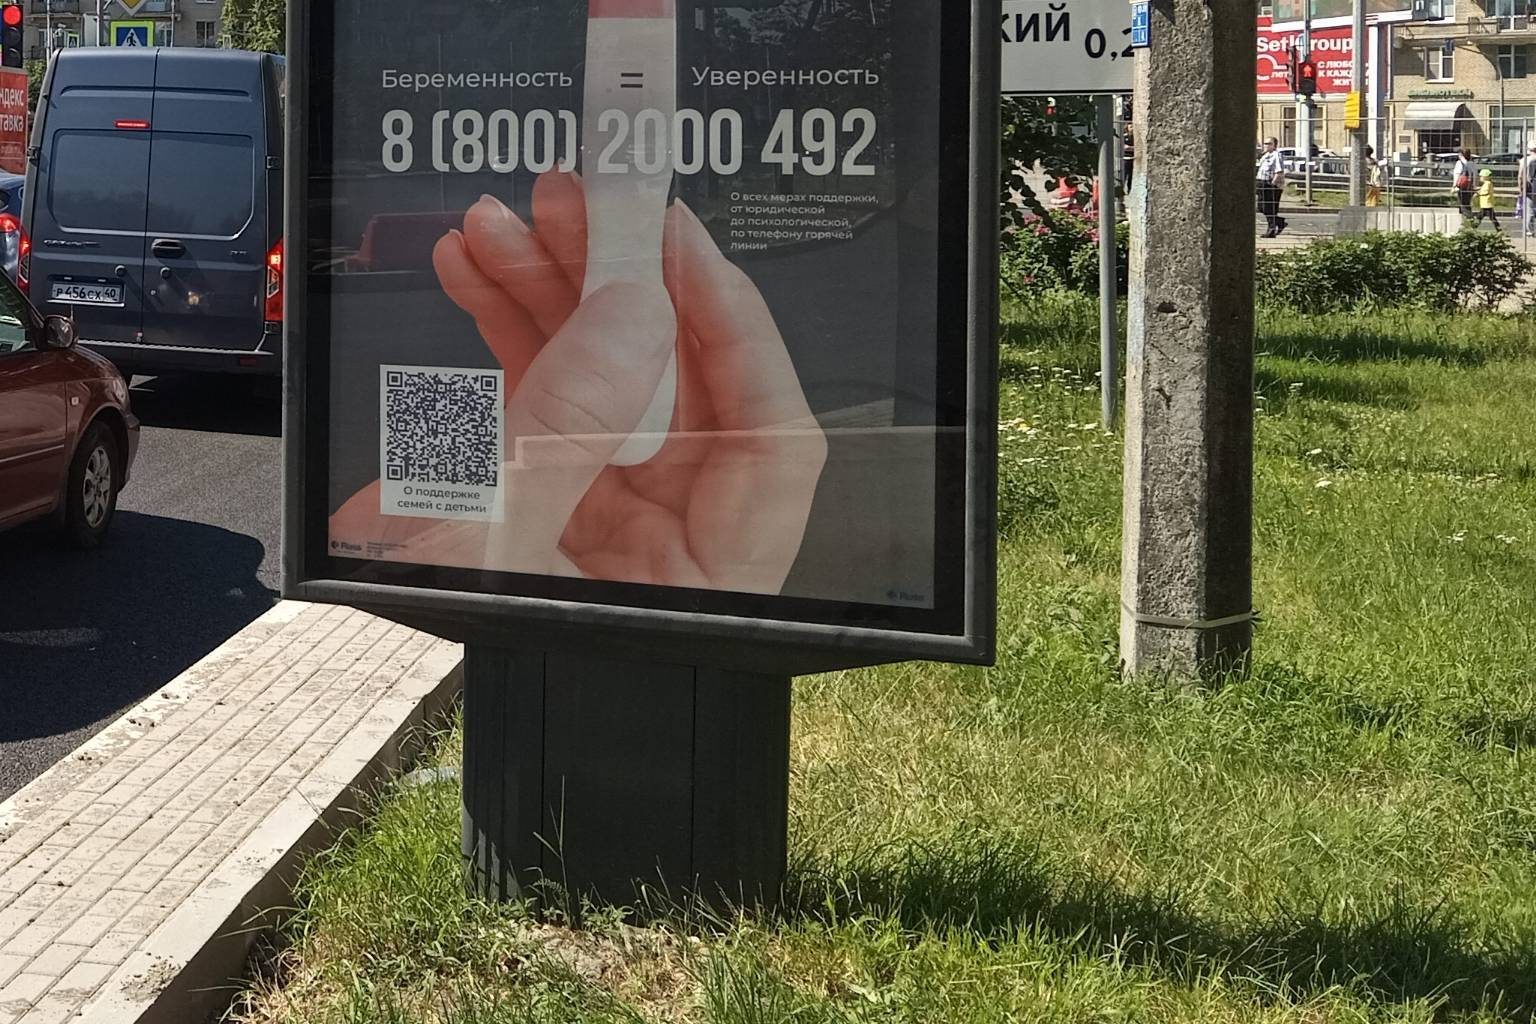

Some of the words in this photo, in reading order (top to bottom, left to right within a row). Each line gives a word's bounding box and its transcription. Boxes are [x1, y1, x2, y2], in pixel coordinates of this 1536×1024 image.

[381, 67, 573, 91] Беременность
[691, 65, 879, 90] Уверенность
[381, 108, 414, 173] 8
[432, 107, 578, 174] (800)
[597, 107, 743, 175] 2000
[761, 107, 877, 176] 492
[730, 192, 740, 201] О
[742, 193, 769, 202] всех
[770, 193, 807, 205] мерах
[809, 193, 879, 205] поддержки,
[730, 205, 743, 214] от
[745, 204, 826, 216] юридической
[730, 217, 745, 227] до
[747, 217, 852, 228] психологической,
[730, 229, 745, 238] по
[747, 229, 803, 241] телефону
[805, 230, 853, 240] горячей
[730, 242, 768, 251] линии
[403, 486, 413, 496] О
[415, 487, 481, 500] поддержке
[397, 499, 433, 510] семей
[435, 502, 443, 510] с
[444, 502, 487, 513] детьми
